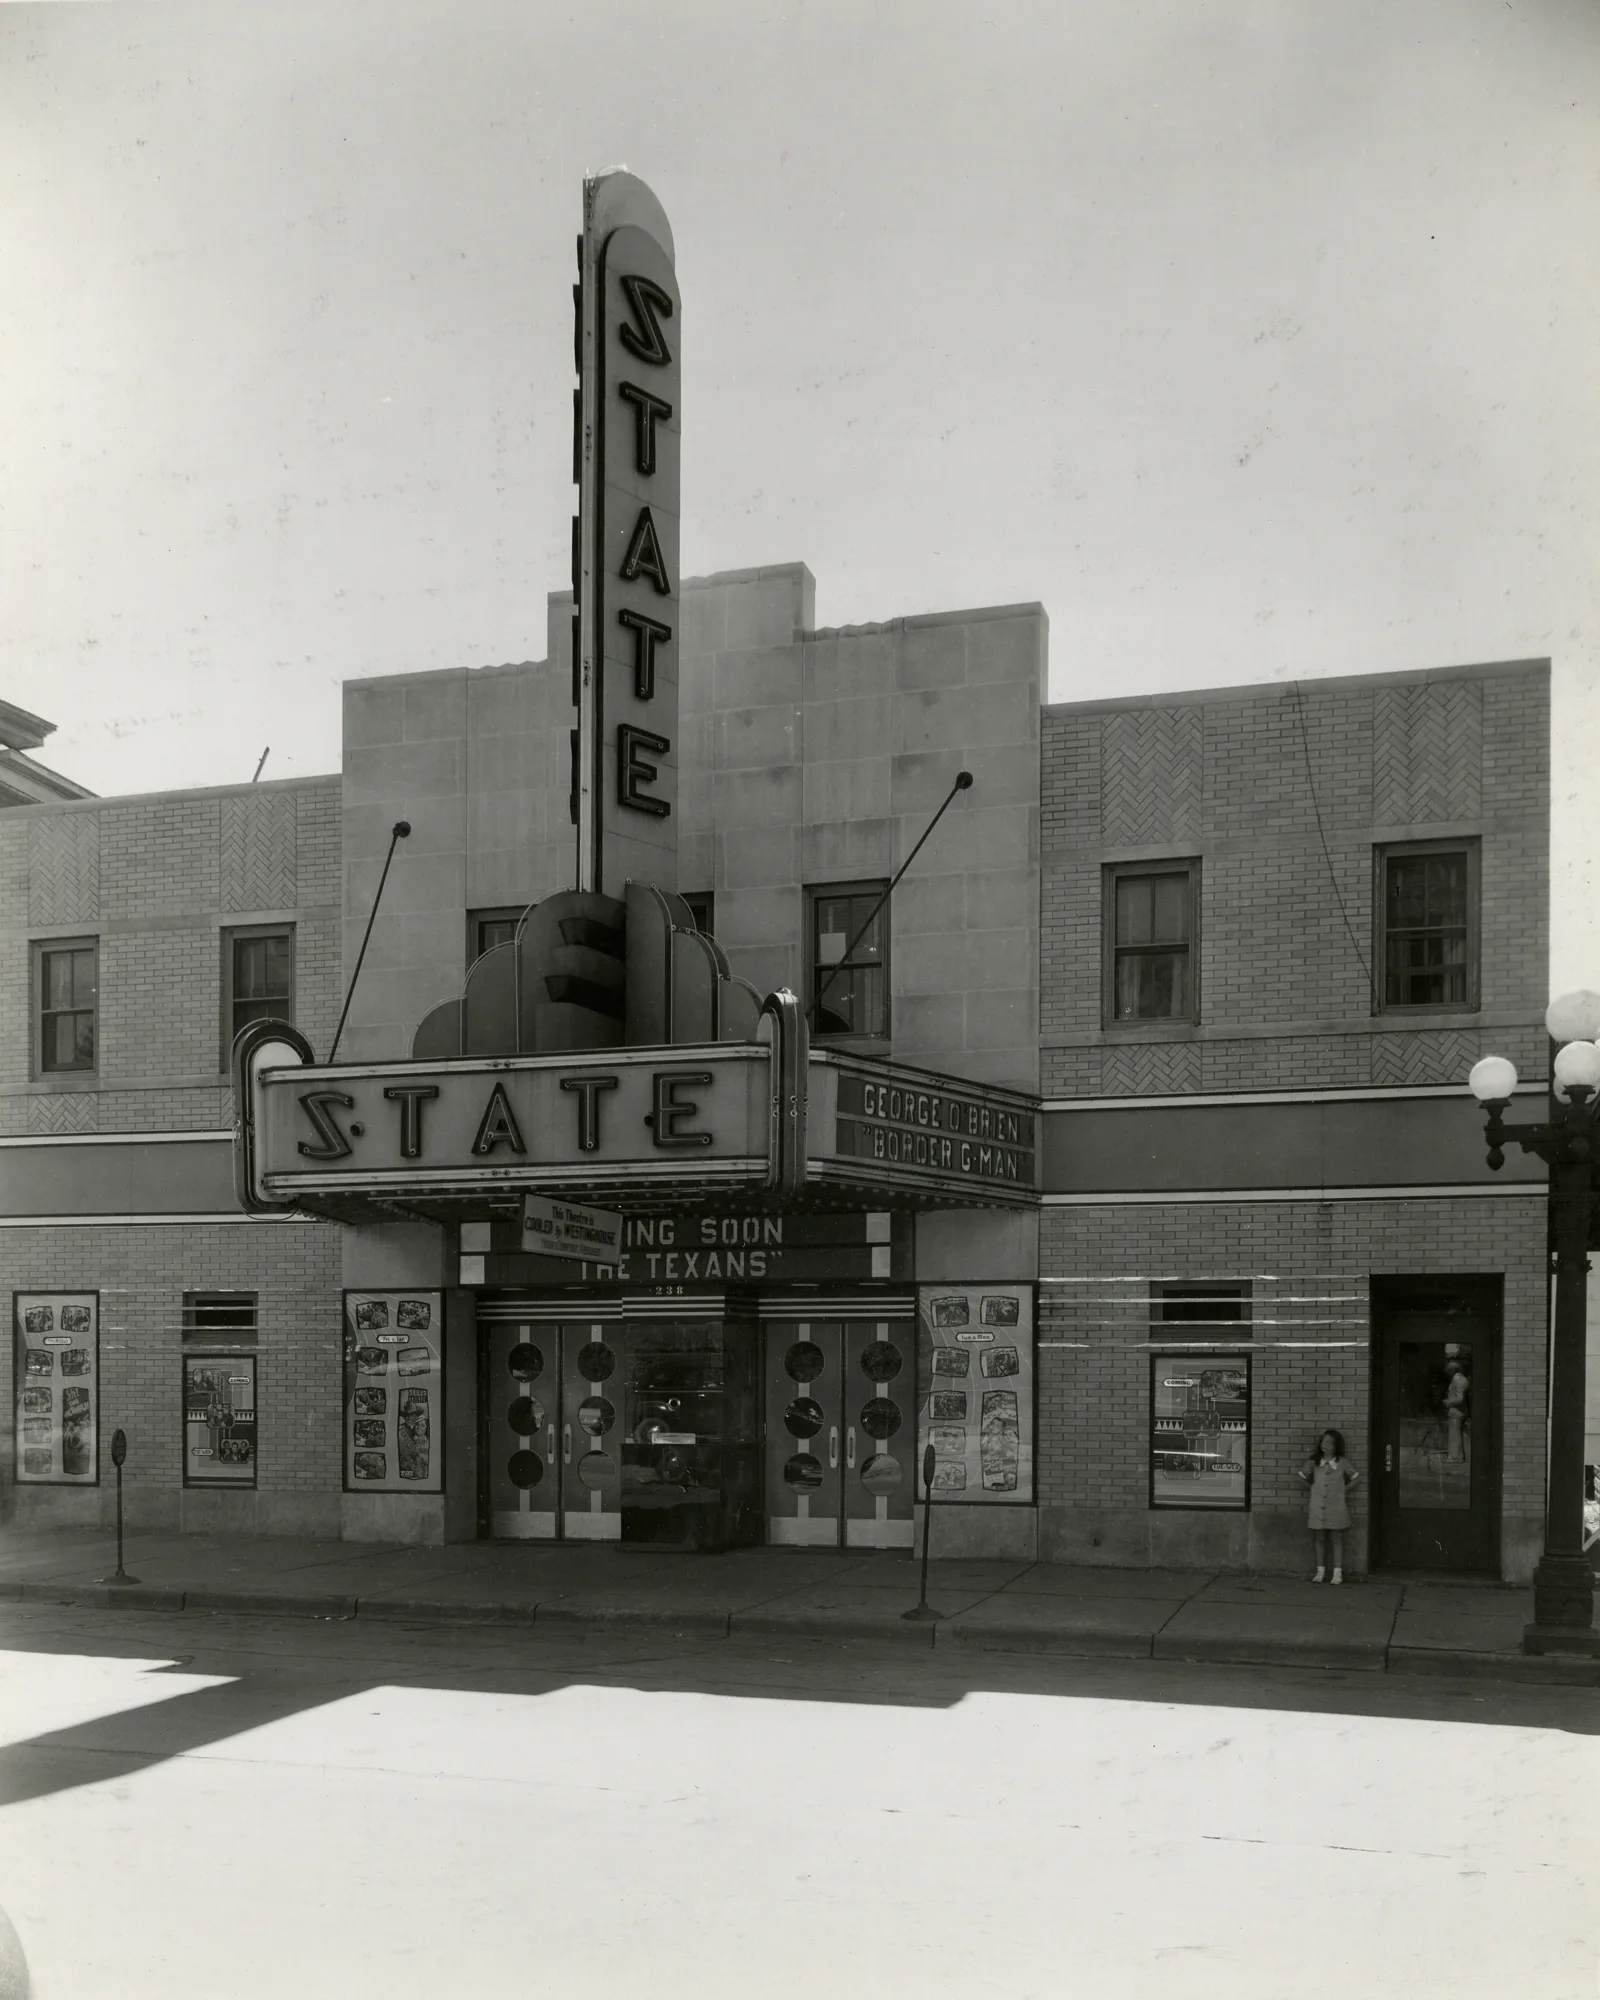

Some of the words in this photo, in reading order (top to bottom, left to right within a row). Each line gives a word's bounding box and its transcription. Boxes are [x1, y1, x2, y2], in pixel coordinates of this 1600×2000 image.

[617, 274, 673, 817] STATE
[297, 1071, 713, 1160] STATE
[863, 1083, 941, 1128] GEORGE
[949, 1102, 1018, 1142] O'BRIEN
[552, 1205, 564, 1220] This
[565, 1208, 588, 1225] Theatre
[524, 1216, 553, 1234] COOLED
[564, 1223, 616, 1245] WESTINGHOUSE
[700, 1217, 783, 1245] SOON
[645, 1250, 783, 1279] TEXANS"
[655, 1285, 684, 1296] 238
